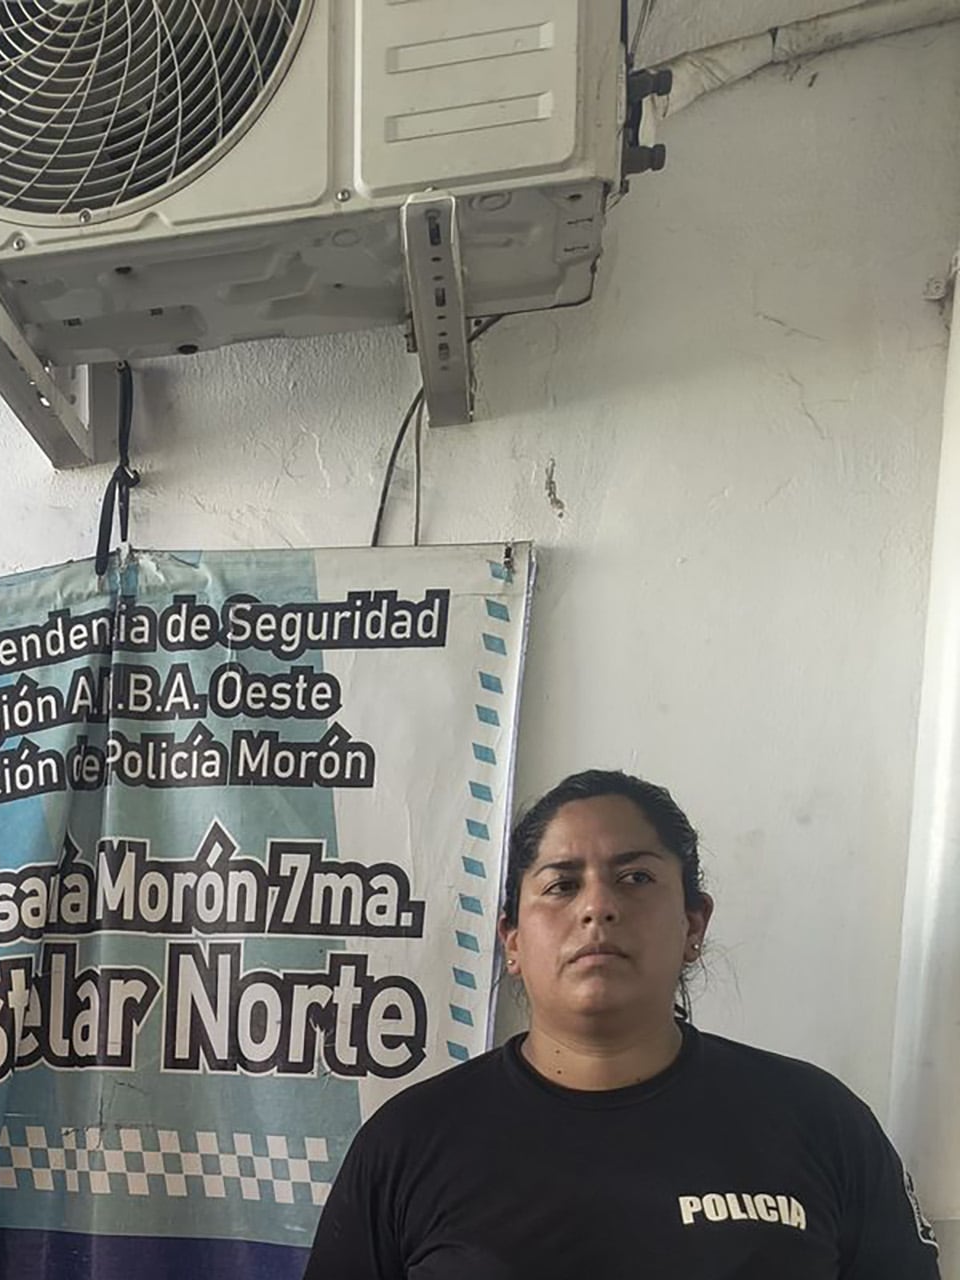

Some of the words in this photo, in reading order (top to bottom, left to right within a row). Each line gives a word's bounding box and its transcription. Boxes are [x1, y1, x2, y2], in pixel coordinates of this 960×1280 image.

[166, 602, 212, 643] de
[228, 597, 441, 652] Seguridad
[216, 671, 333, 711] Oeste
[74, 744, 100, 782] de
[105, 734, 220, 779] Policía
[238, 735, 366, 779] Morón
[96, 842, 258, 924] Morón
[175, 953, 416, 1068] Norte
[678, 1193, 807, 1230] POLICIA
